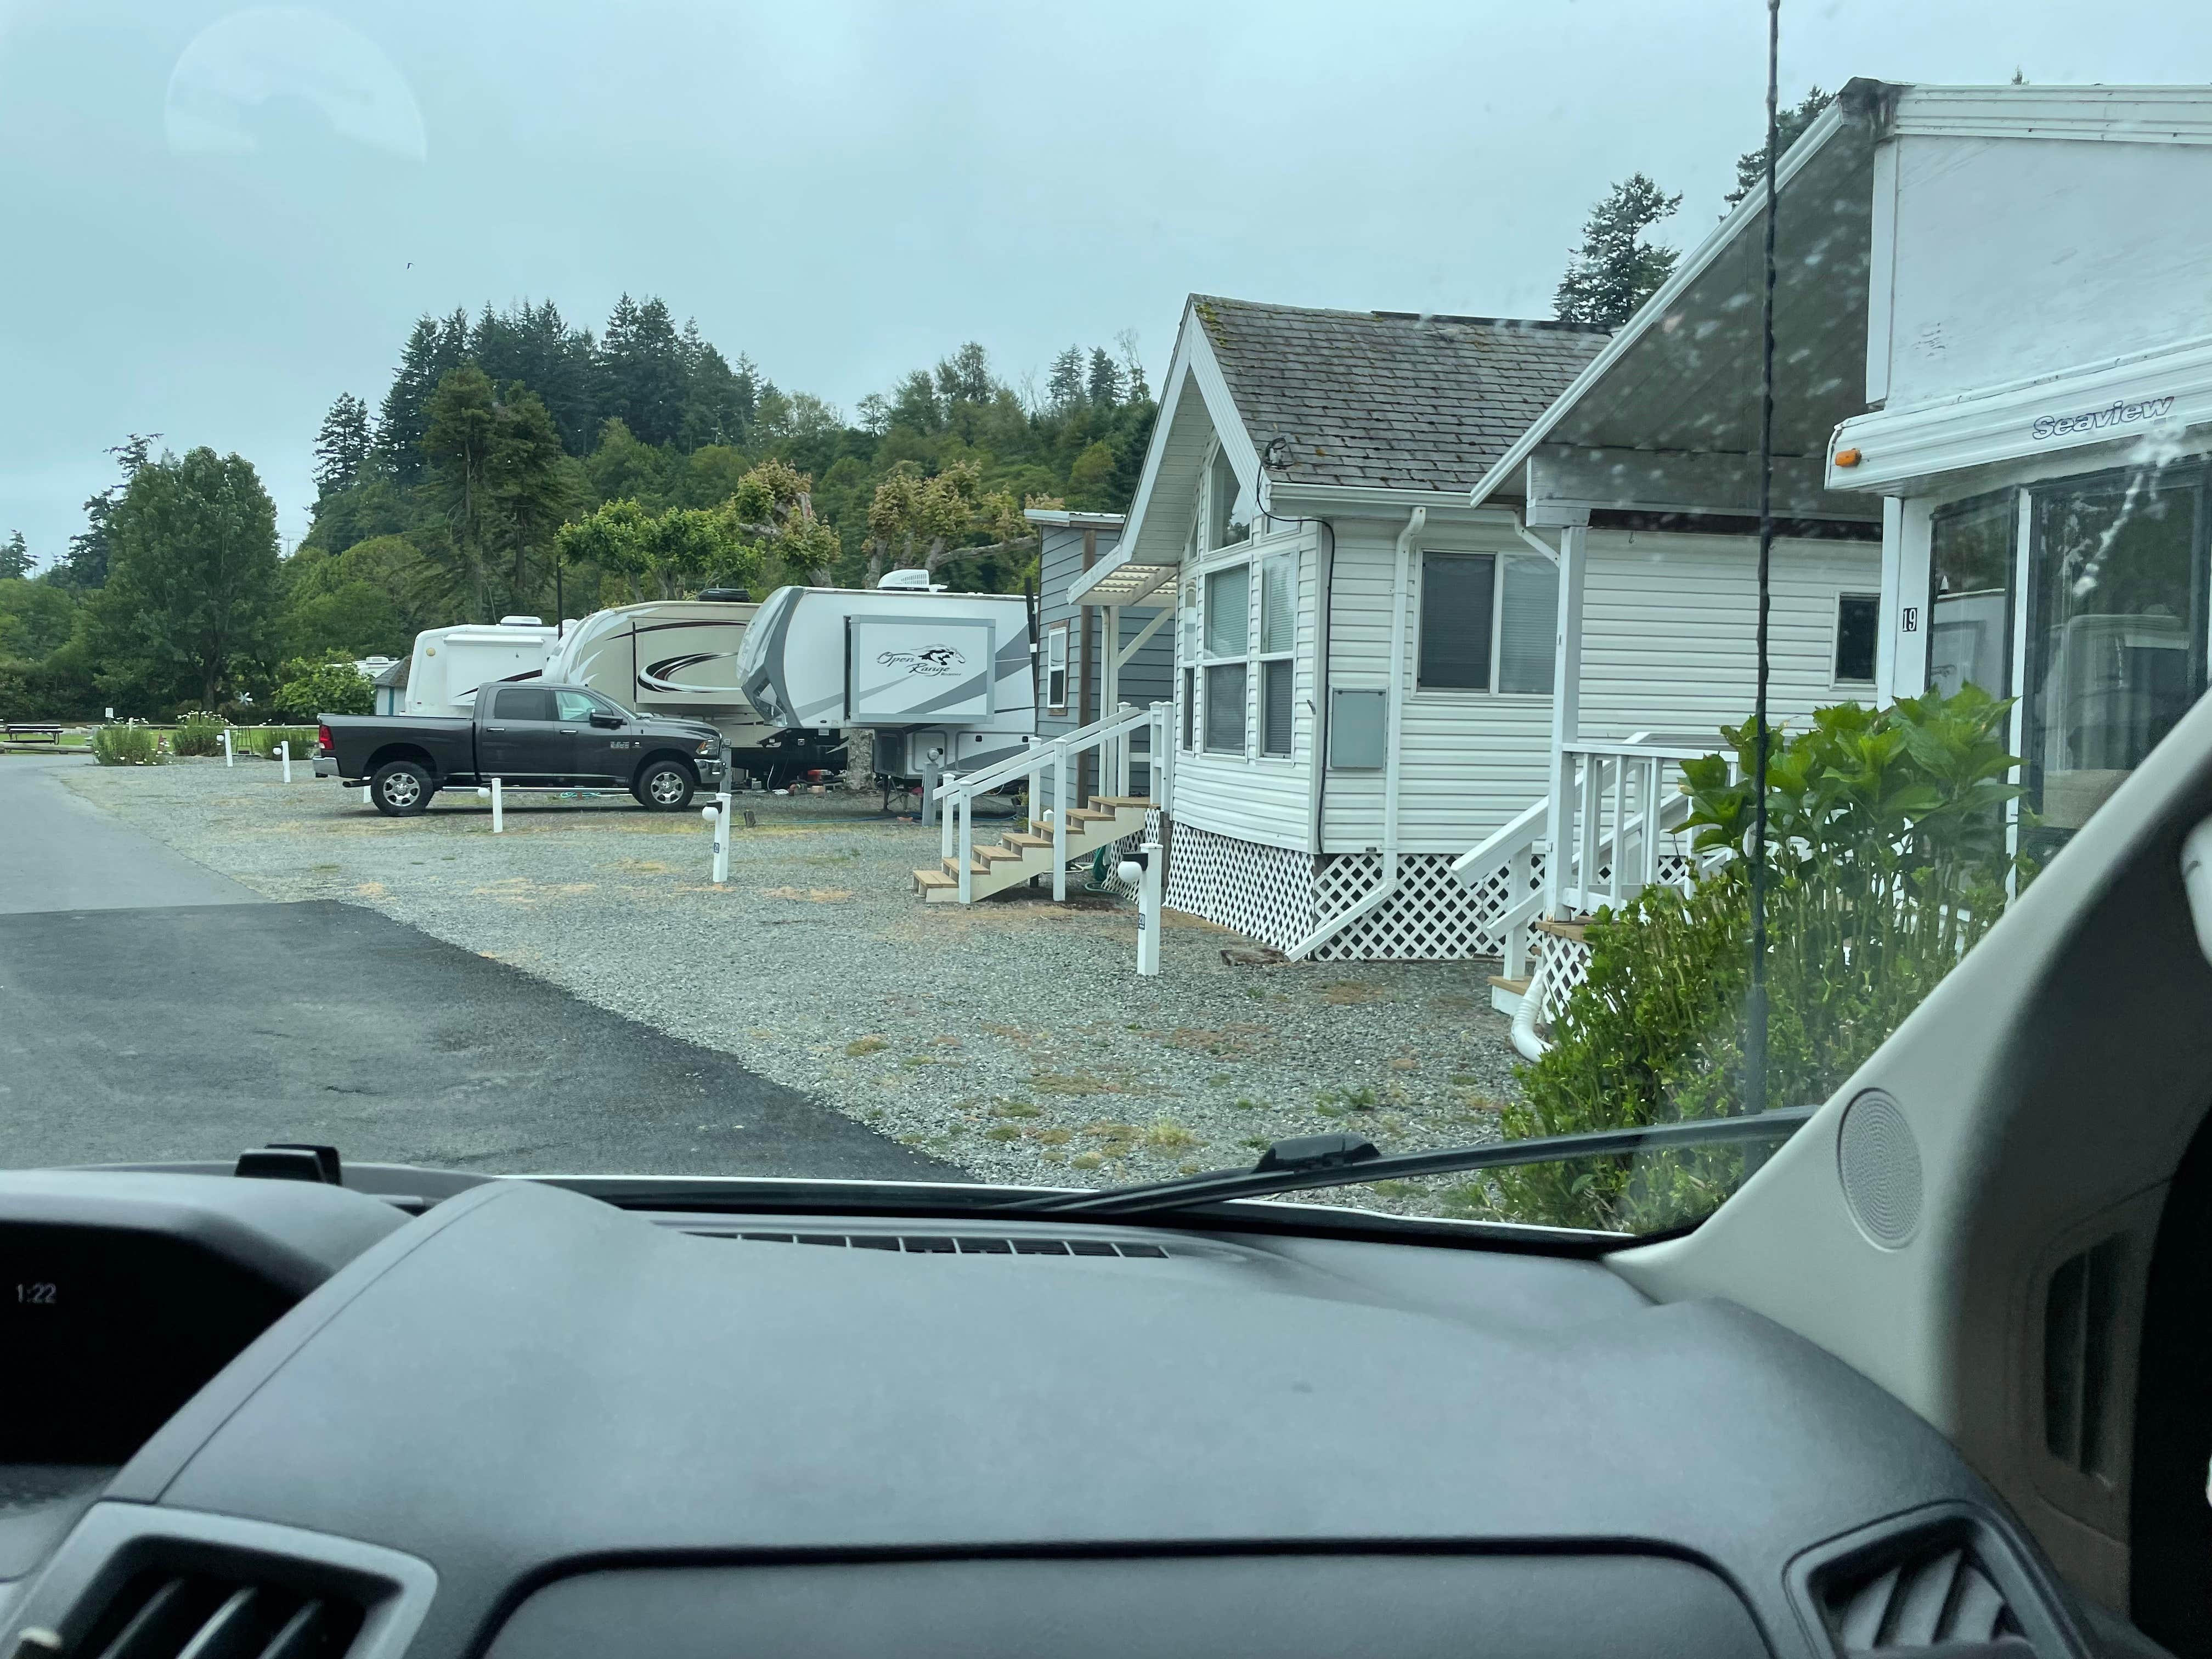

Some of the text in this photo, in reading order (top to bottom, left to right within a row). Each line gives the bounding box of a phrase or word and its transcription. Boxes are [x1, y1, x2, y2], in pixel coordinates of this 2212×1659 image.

[2032, 396, 2175, 439] Seaview
[1903, 608, 1917, 631] 19
[877, 651, 916, 667] Open
[906, 663, 950, 676] Range
[18, 1283, 57, 1304] 1:22
